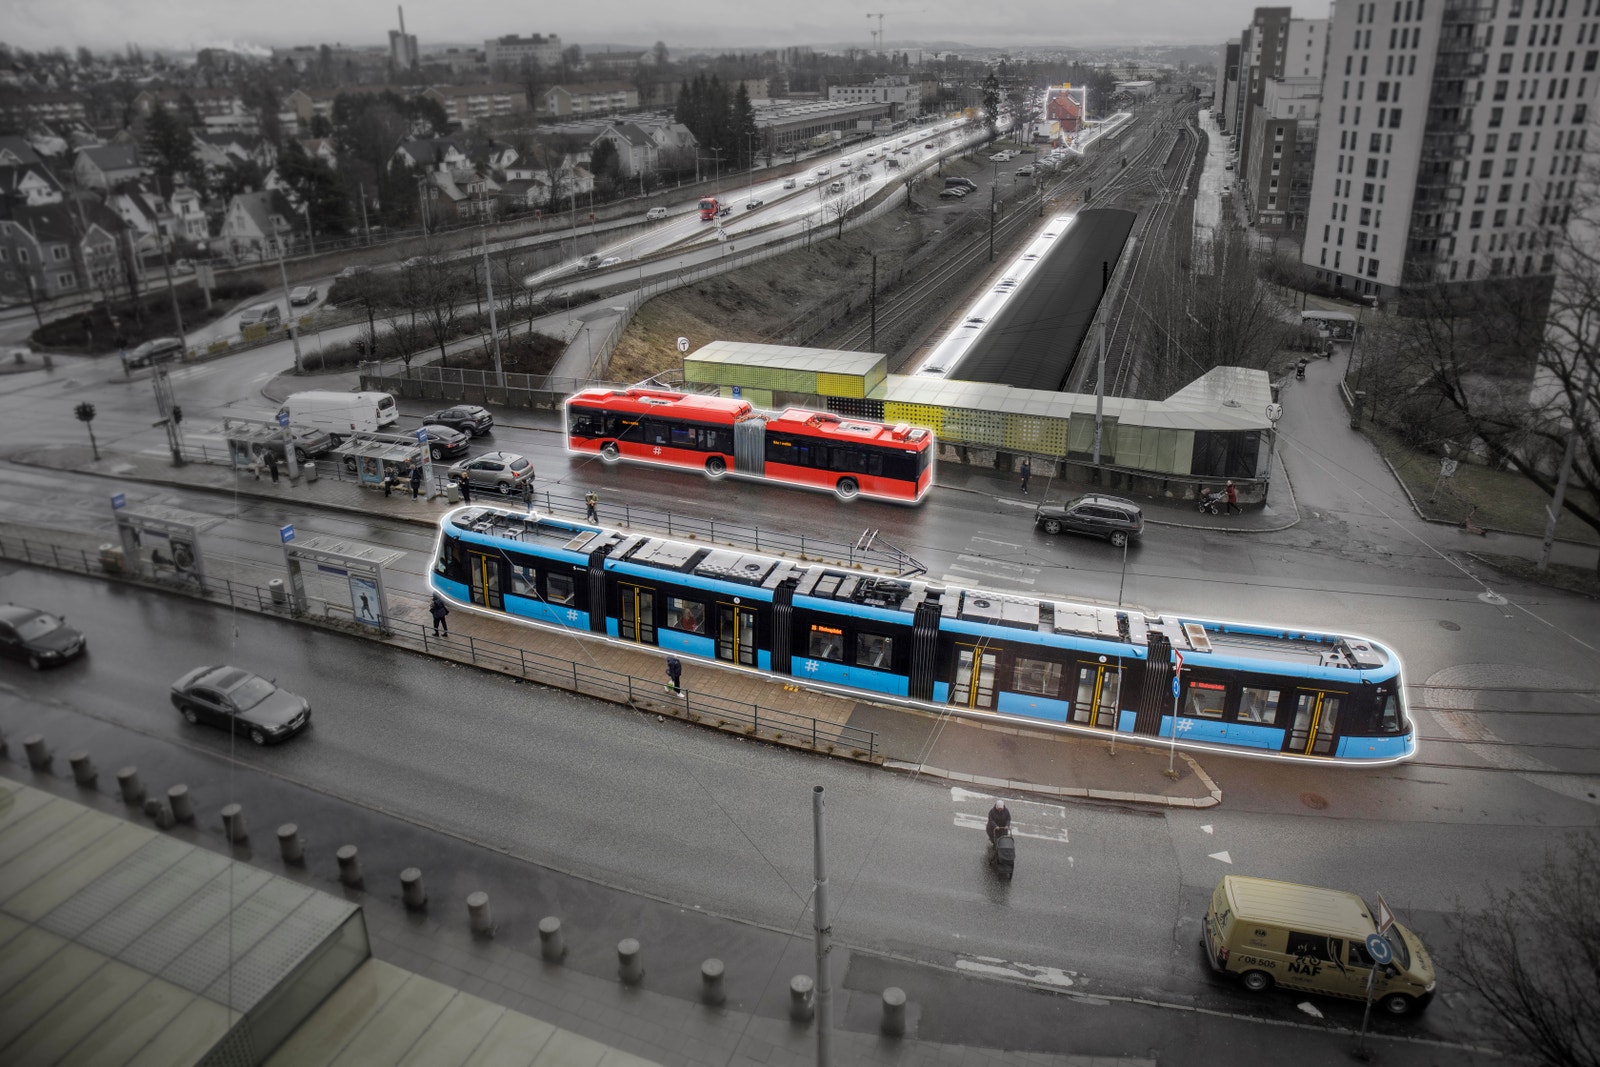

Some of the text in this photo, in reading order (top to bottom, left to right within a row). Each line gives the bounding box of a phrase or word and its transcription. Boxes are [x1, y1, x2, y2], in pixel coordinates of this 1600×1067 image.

[1245, 956, 1276, 968] 08 505
[1288, 962, 1322, 976] NAF
